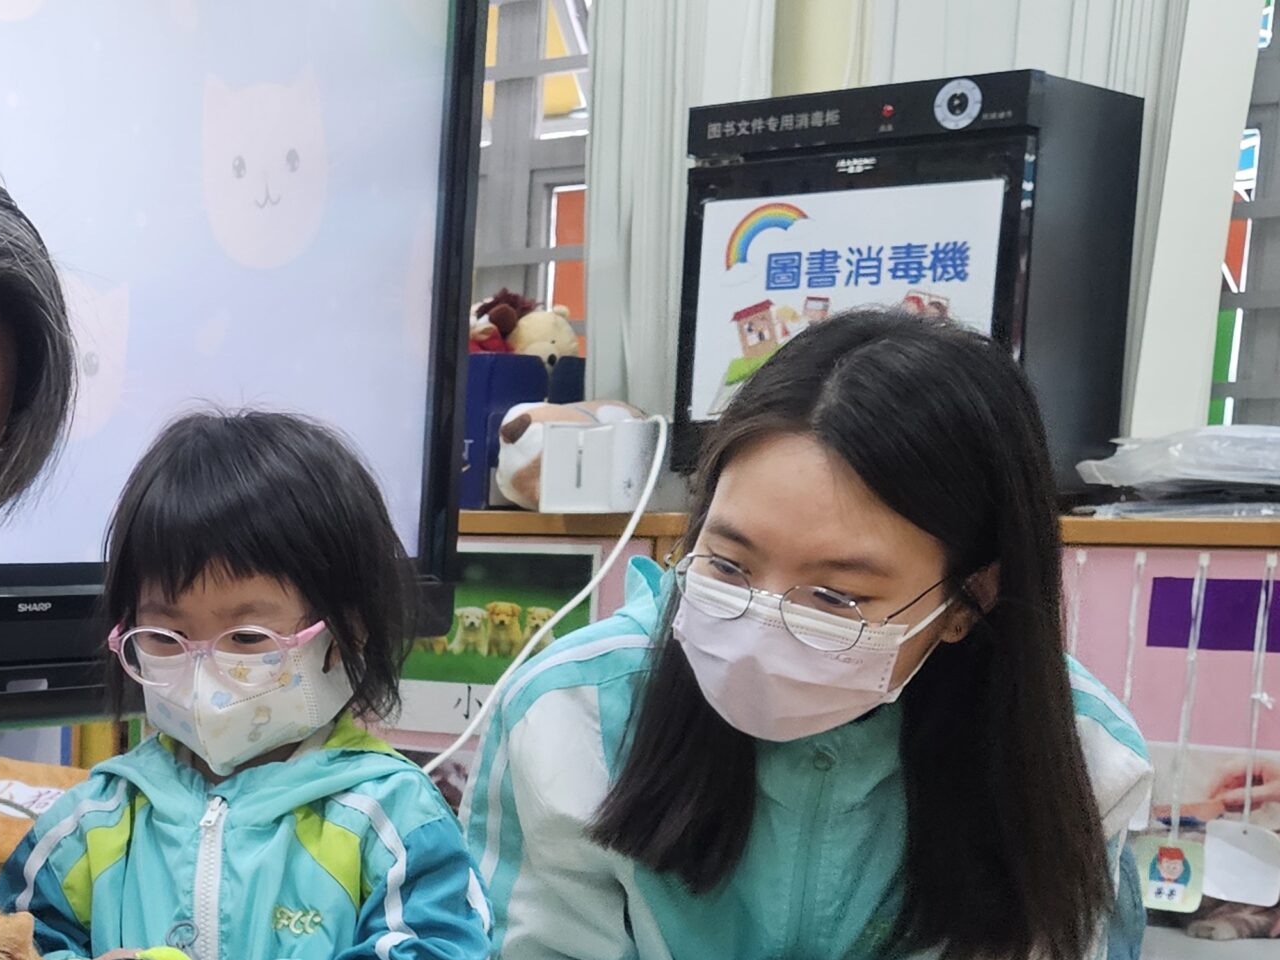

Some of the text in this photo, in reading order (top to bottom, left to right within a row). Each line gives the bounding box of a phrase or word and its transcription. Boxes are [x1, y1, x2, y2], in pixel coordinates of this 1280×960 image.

[706, 109, 840, 139] 图书文件专用消毒柜
[765, 241, 971, 291] 圖書消毒機
[17, 602, 52, 612] SHARP
